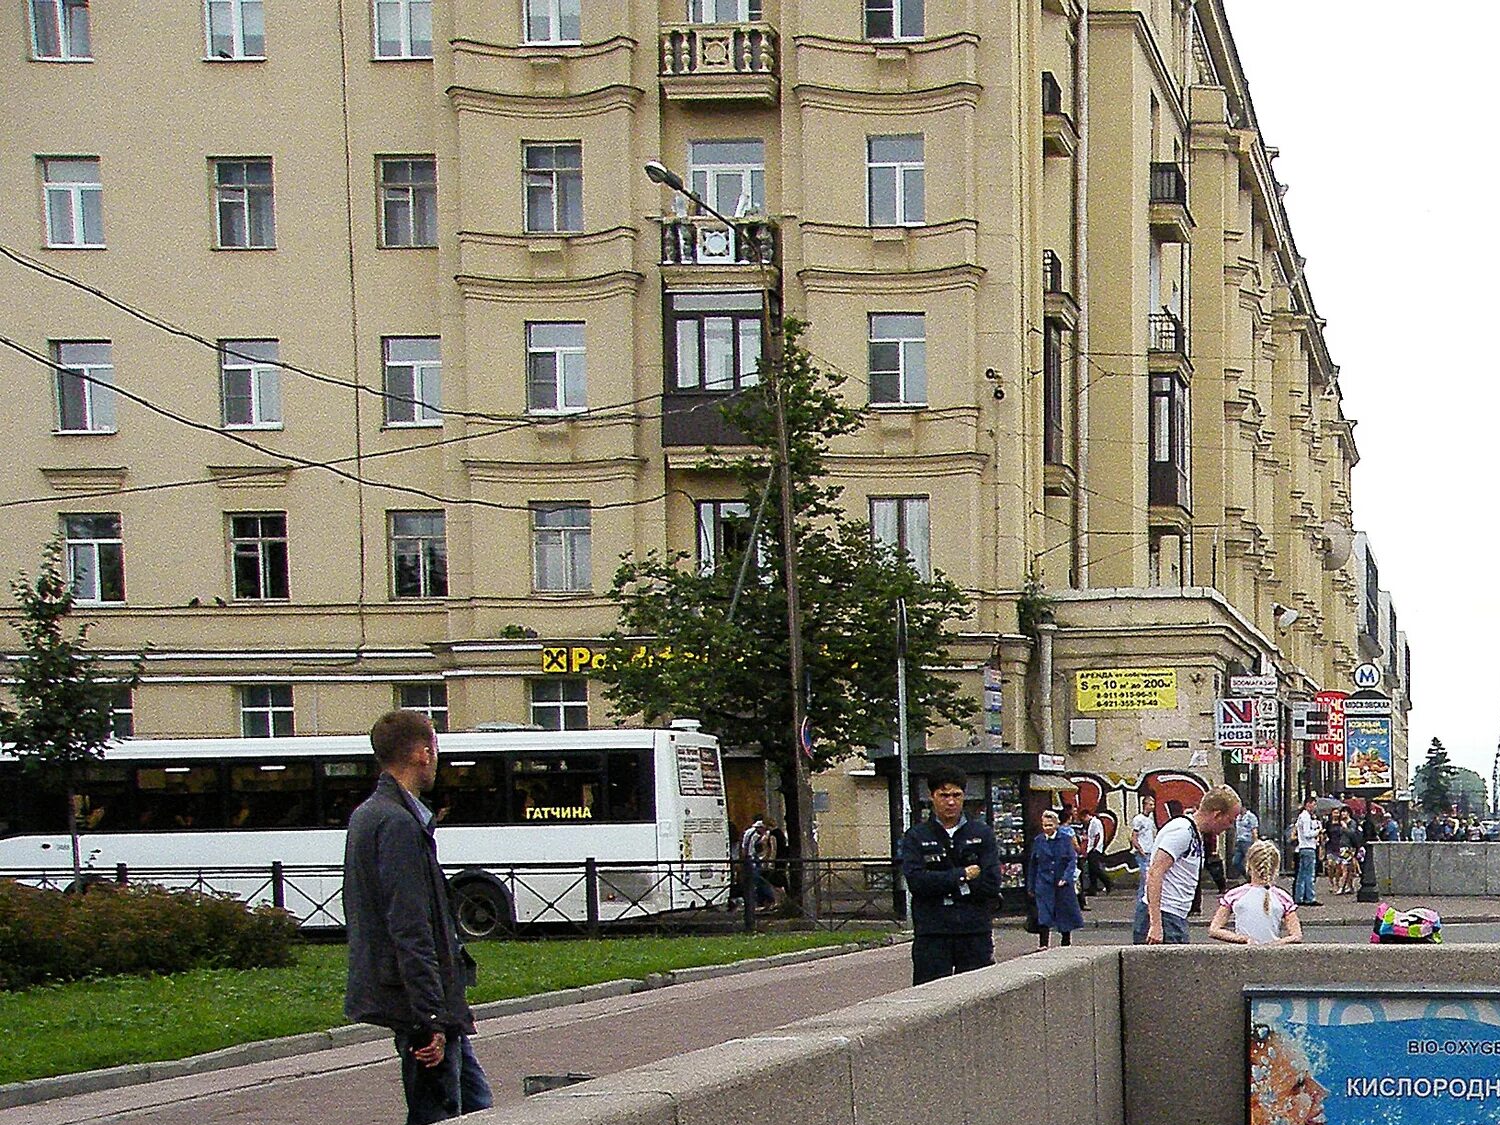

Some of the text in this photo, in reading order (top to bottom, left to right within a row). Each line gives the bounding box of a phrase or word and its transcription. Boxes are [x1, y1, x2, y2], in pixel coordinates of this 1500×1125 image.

[1080, 671, 1113, 679] АРЕНДА
[1359, 668, 1375, 683] М
[1080, 681, 1089, 690] S
[1103, 680, 1117, 689] 10
[525, 805, 593, 820] ГАТЧИНА
